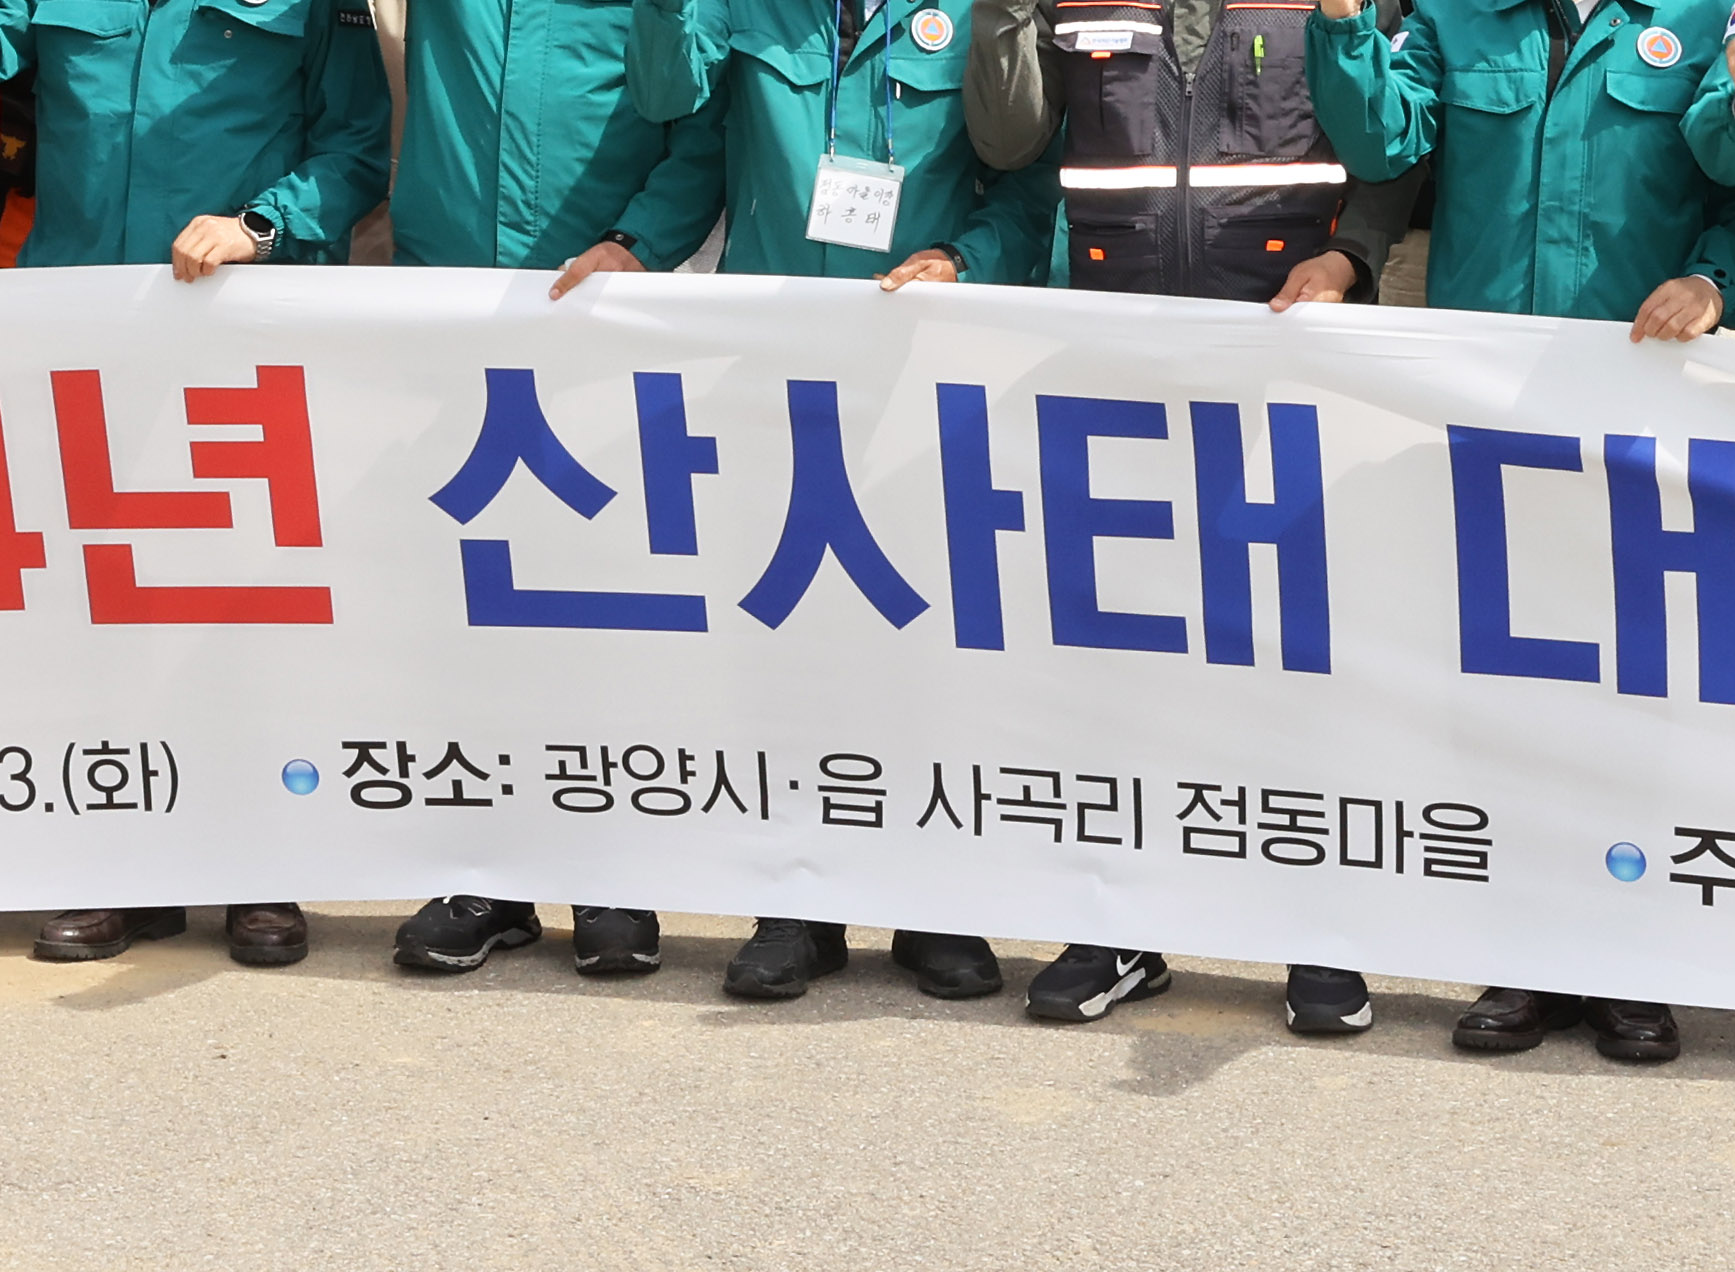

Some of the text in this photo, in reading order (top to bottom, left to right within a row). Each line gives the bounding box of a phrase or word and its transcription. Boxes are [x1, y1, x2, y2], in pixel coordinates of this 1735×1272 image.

[429, 369, 1331, 674] 산사태
[341, 740, 514, 810] 장소:
[916, 762, 1144, 851] 사곡리
[1176, 781, 1494, 883] 점동마을
